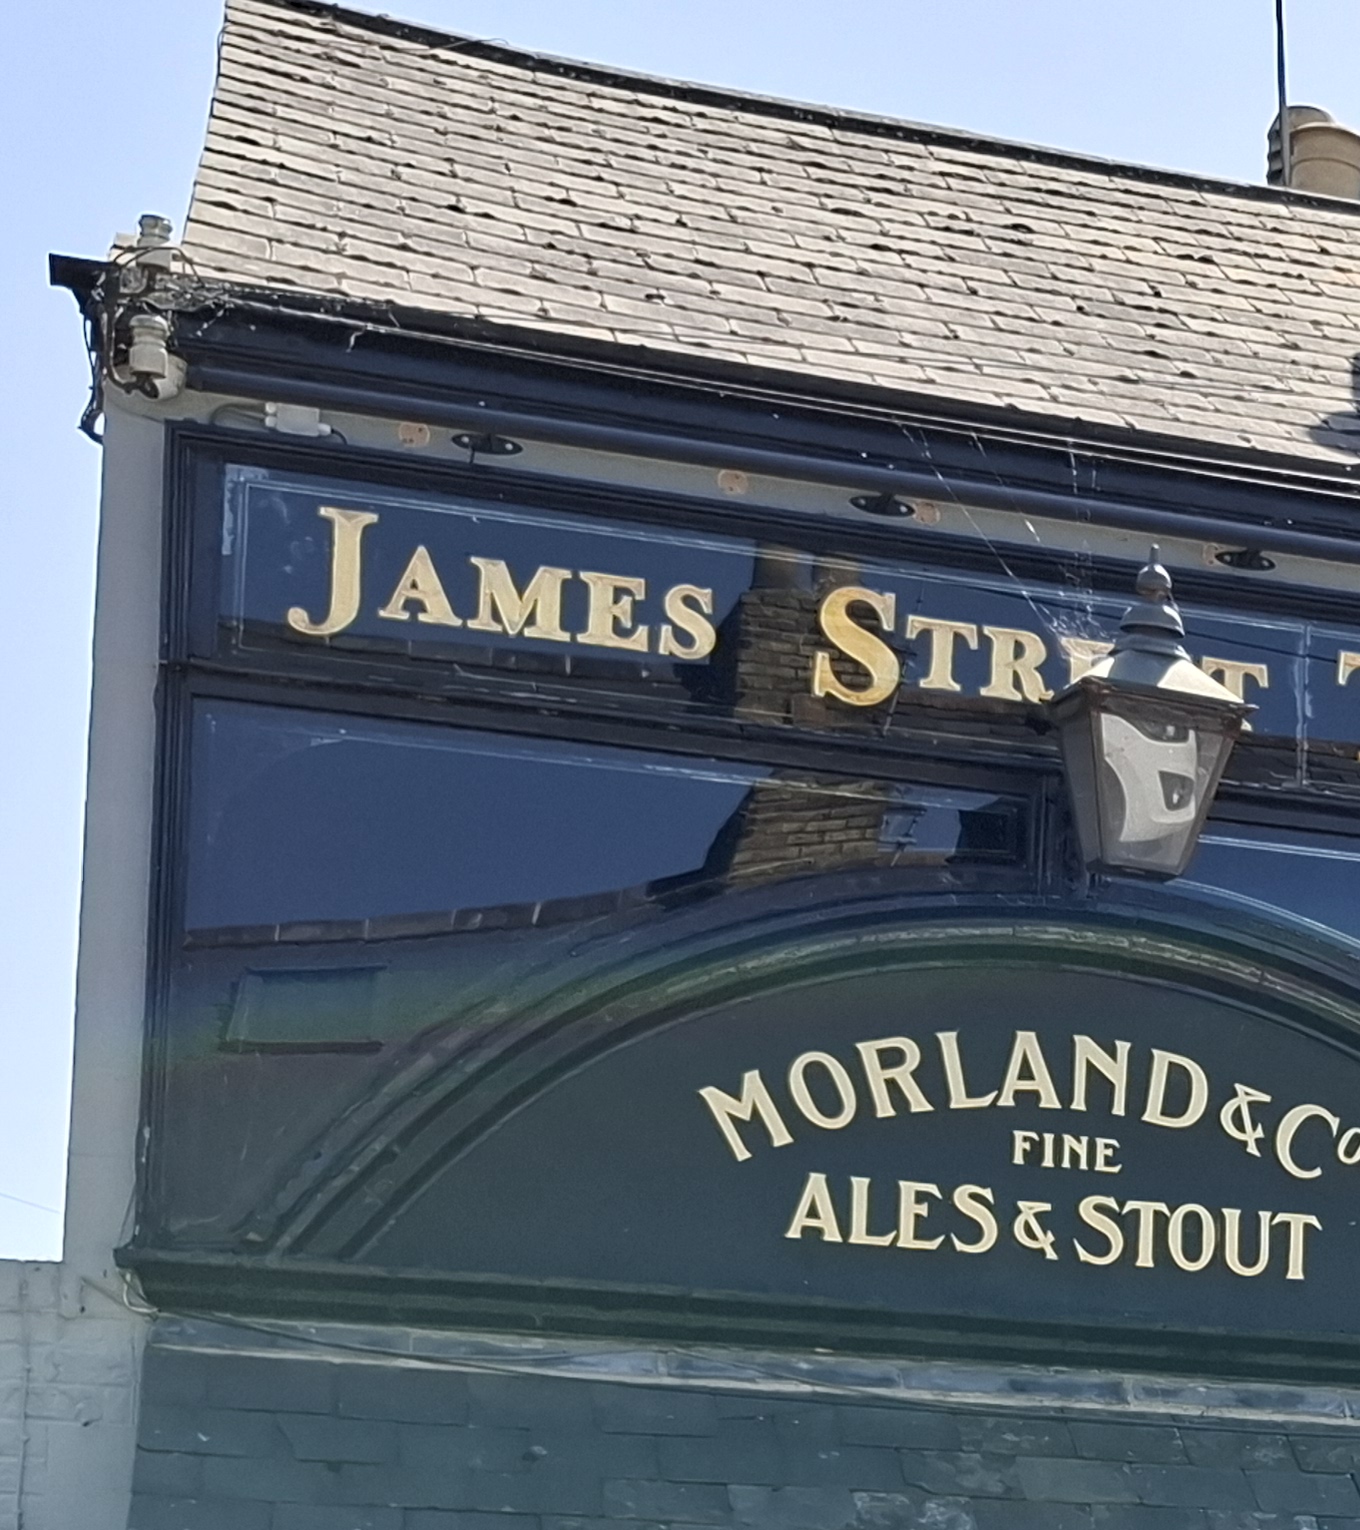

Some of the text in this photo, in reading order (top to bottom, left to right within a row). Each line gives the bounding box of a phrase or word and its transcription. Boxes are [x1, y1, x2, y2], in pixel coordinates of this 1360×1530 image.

[287, 506, 717, 660] JAMES
[812, 586, 1269, 732] STRT
[697, 1030, 1208, 1162] MORLAND
[1011, 1130, 1123, 1173] FINE
[784, 1172, 1323, 1281] ALES & STOUT
